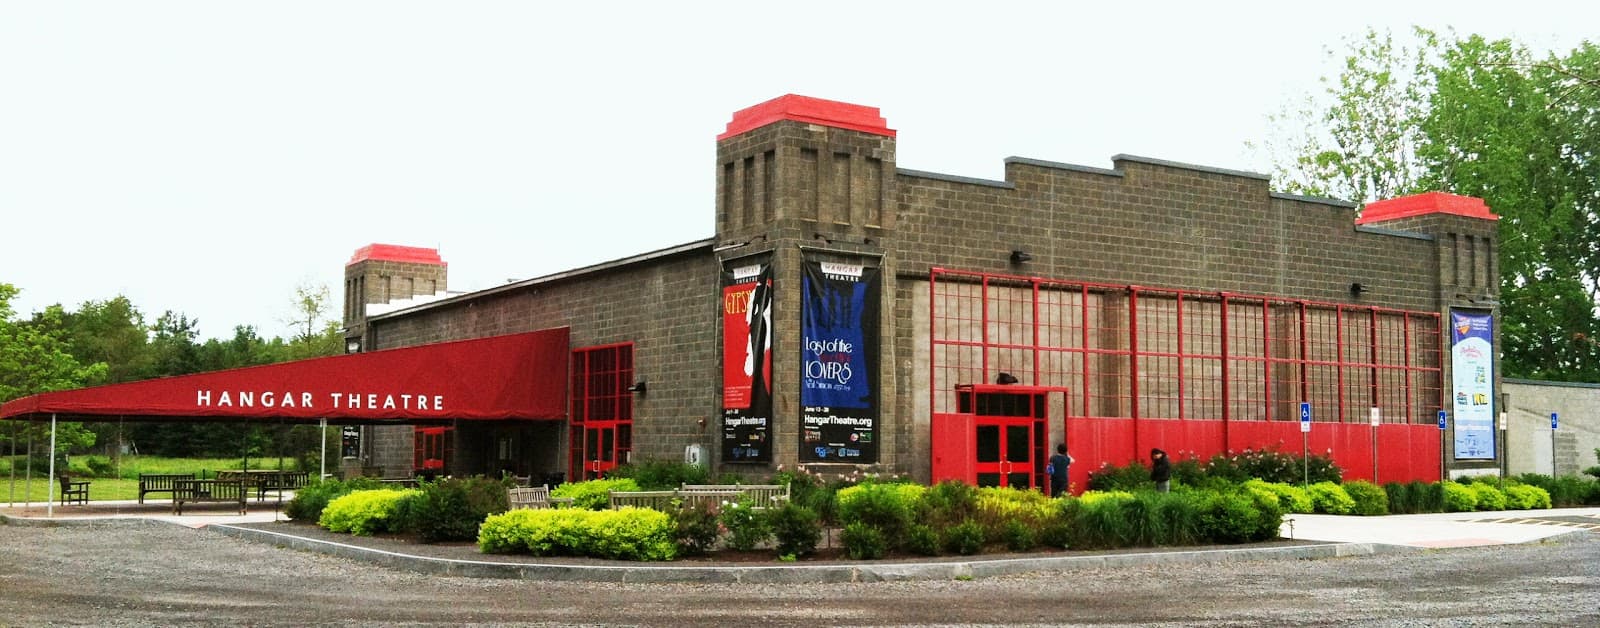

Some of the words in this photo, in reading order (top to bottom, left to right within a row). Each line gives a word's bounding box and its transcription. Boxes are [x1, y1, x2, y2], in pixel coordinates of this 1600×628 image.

[825, 273, 859, 282] THEATRE
[725, 289, 751, 315] GYPSY
[805, 336, 826, 356] Last
[805, 360, 852, 385] LOVERS
[197, 390, 313, 408] HANGAR
[331, 392, 444, 411] THEATRE
[804, 415, 873, 427] HangarTheatre.org
